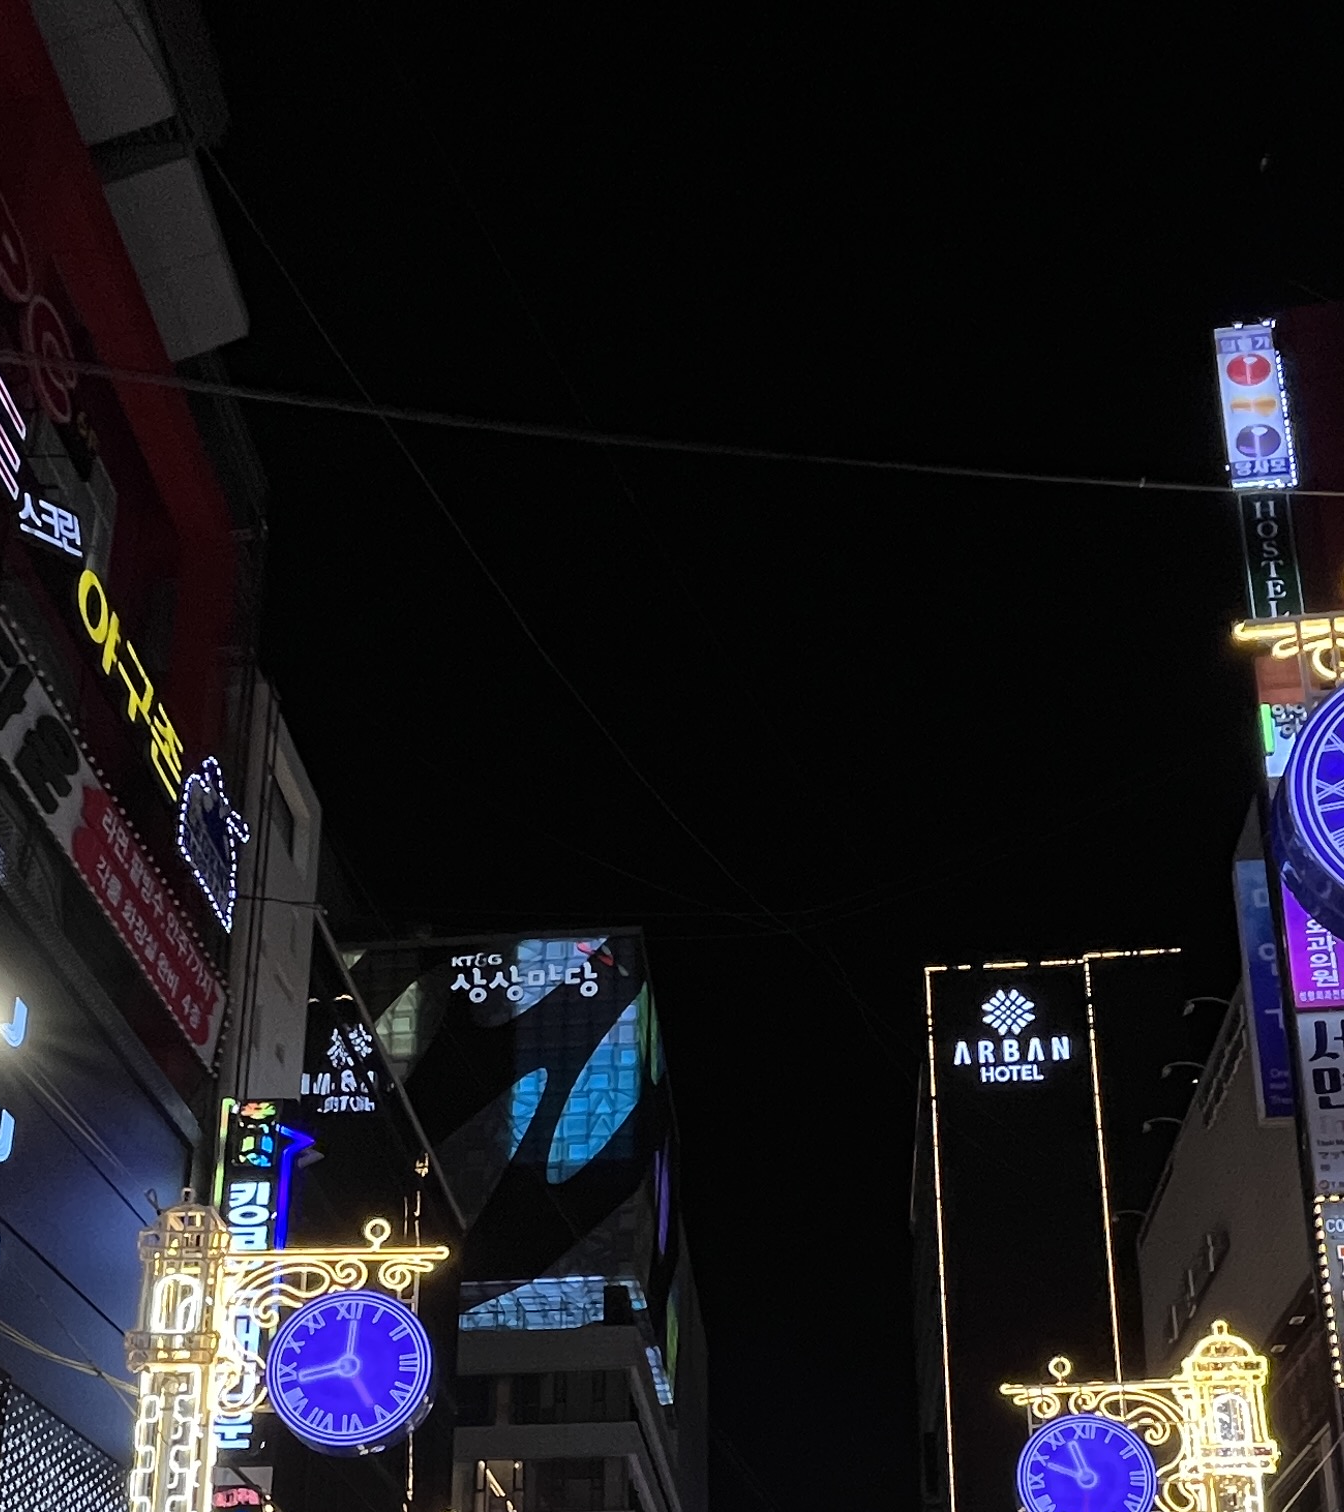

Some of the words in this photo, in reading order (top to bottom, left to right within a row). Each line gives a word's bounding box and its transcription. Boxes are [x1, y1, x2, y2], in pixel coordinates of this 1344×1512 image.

[1255, 500, 1290, 618] HOSTEL
[19, 493, 83, 557] 스크린
[78, 569, 183, 802] 야구존
[451, 953, 502, 967] KT&G
[450, 962, 598, 1003] 상상마당
[954, 1036, 1071, 1066] ARBAN
[980, 1064, 1045, 1083] HOTEL
